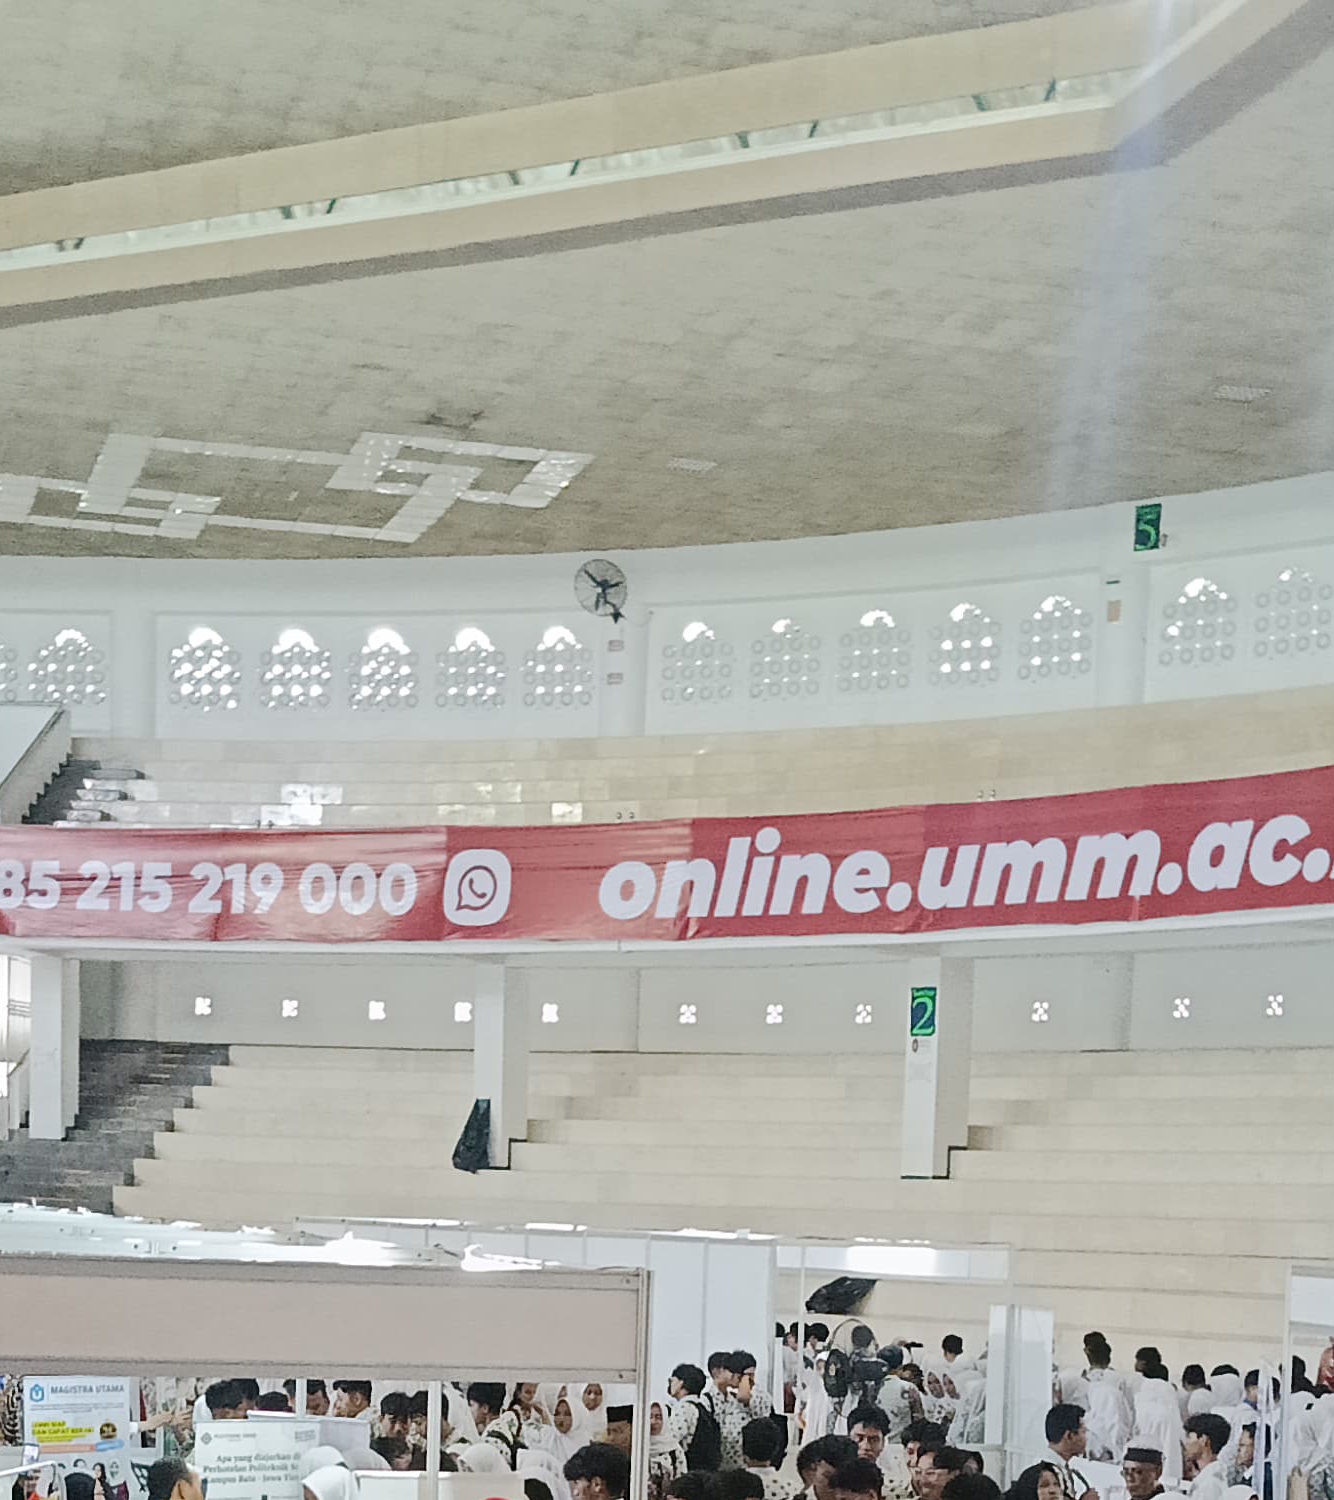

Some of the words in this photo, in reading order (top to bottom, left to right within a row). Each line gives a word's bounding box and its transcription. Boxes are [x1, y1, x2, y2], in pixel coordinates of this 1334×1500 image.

[1136, 514, 1157, 550] 5
[75, 859, 174, 914] 215
[186, 861, 284, 916] 219
[297, 862, 419, 917] 000
[912, 996, 933, 1034] 2
[96, 1384, 126, 1394] UTAMA
